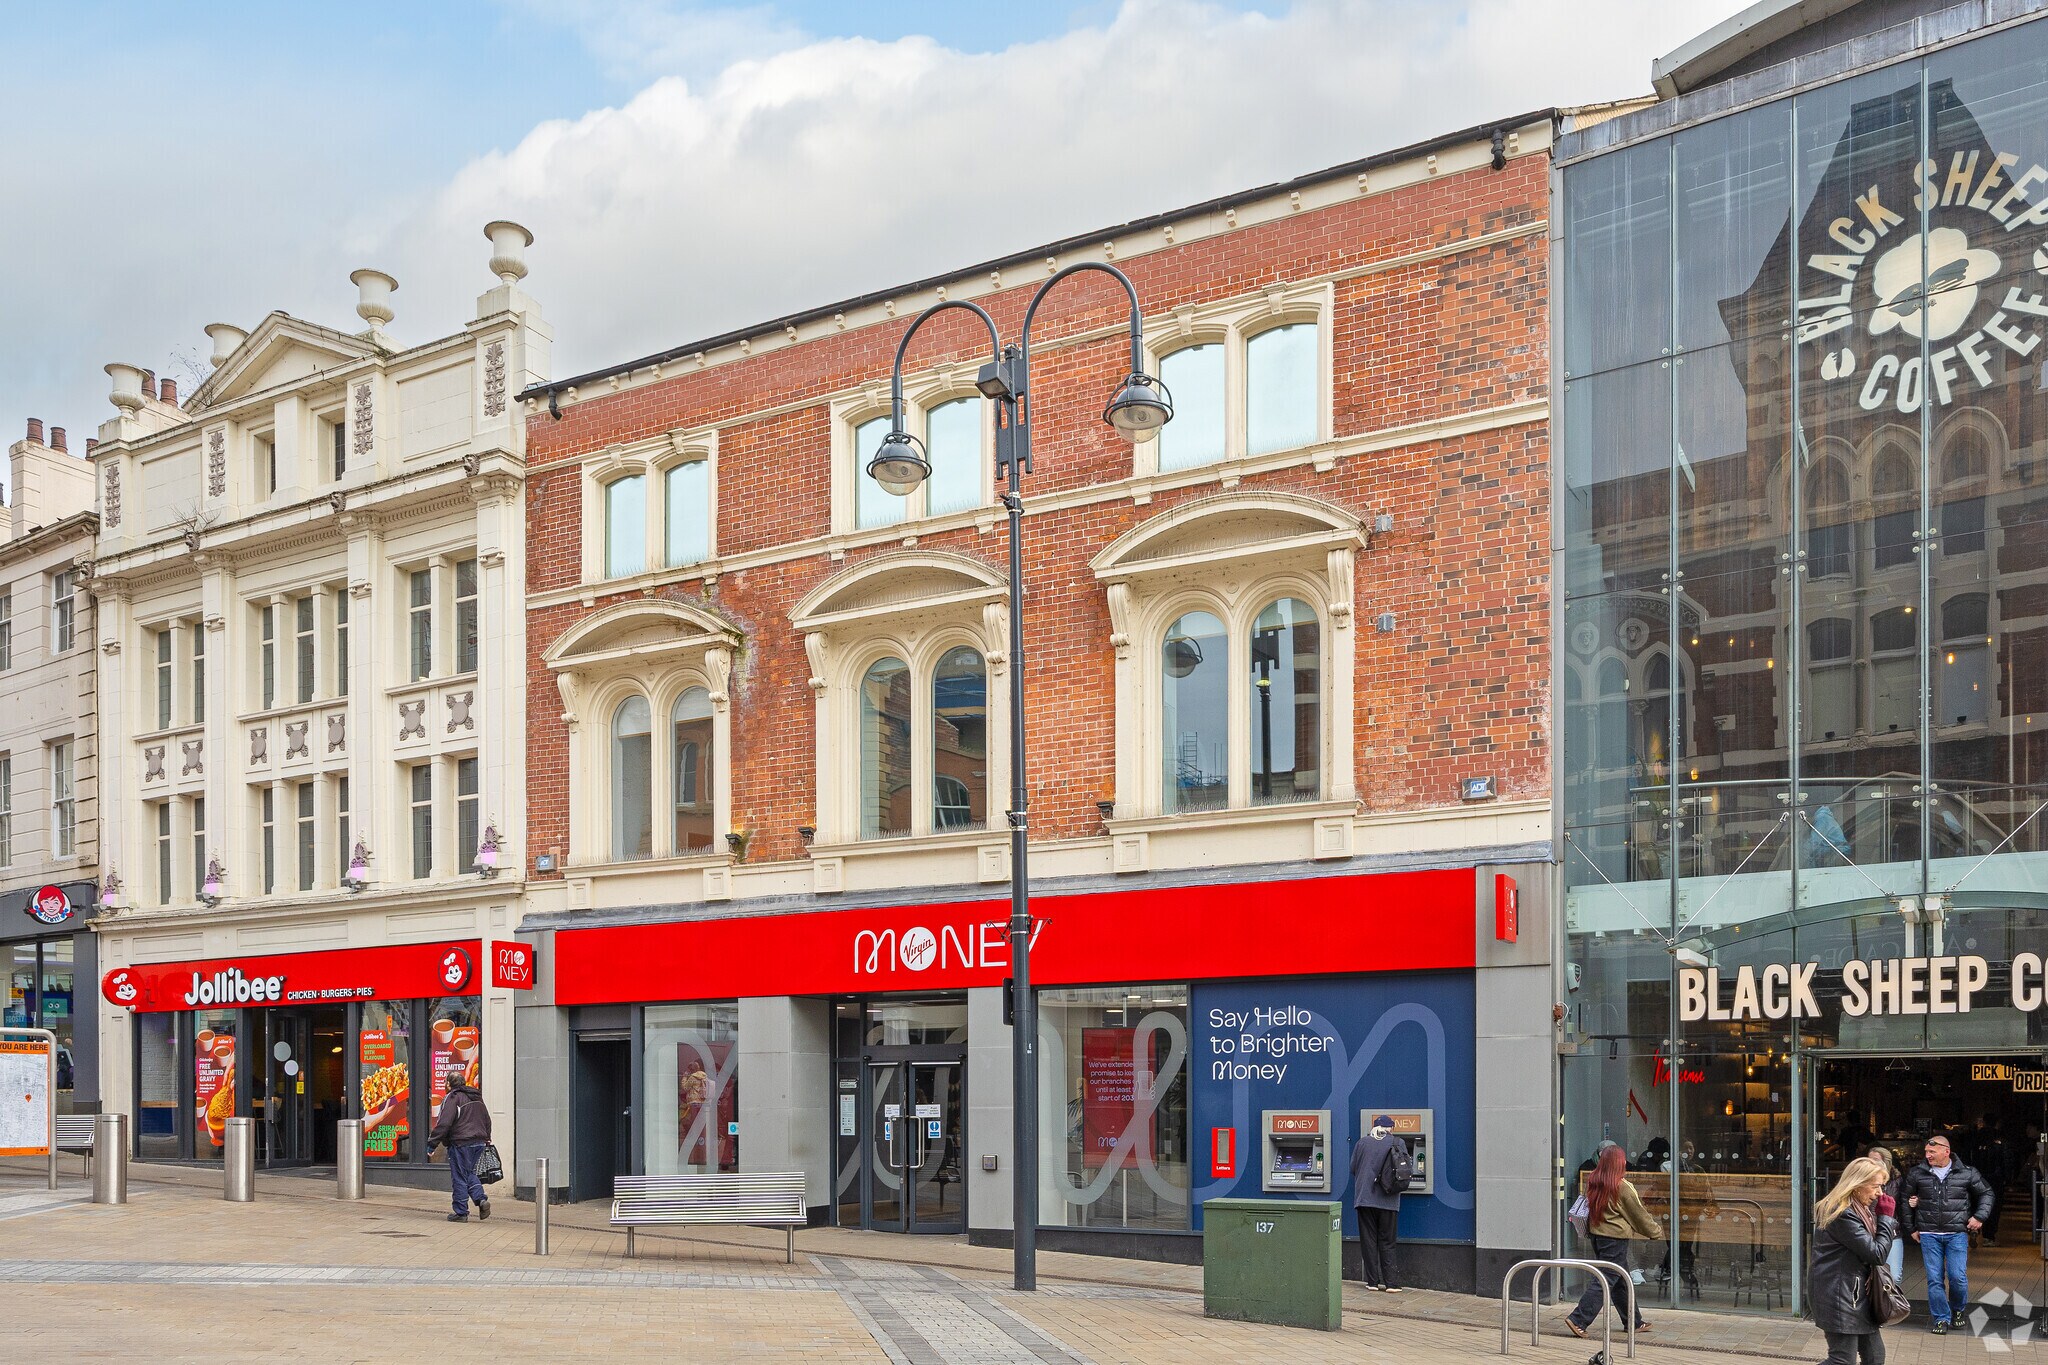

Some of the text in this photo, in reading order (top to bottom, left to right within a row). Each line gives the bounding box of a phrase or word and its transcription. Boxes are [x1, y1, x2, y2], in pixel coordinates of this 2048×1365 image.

[1797, 184, 1905, 345] BLACK
[1859, 287, 2048, 414] COFFEE
[903, 934, 934, 965] Virgin
[500, 965, 529, 981] NEY
[184, 967, 284, 1005] Jollibee
[287, 987, 373, 1000] CHICKEN BURGERS PIES
[1679, 952, 2048, 1022] BLACK SHEEP C
[1209, 1005, 1312, 1031] Say Hello
[1210, 1032, 1334, 1058] to Brighter
[1212, 1061, 1288, 1085] Money
[1973, 1065, 1999, 1079] PICK
[1277, 1119, 1314, 1129] MONEY
[1394, 1119, 1416, 1128] NEY
[367, 1131, 397, 1139] LOADED
[364, 1139, 394, 1152] FRIES
[1256, 1221, 1275, 1234] 137
[1331, 1218, 1340, 1231] 137
